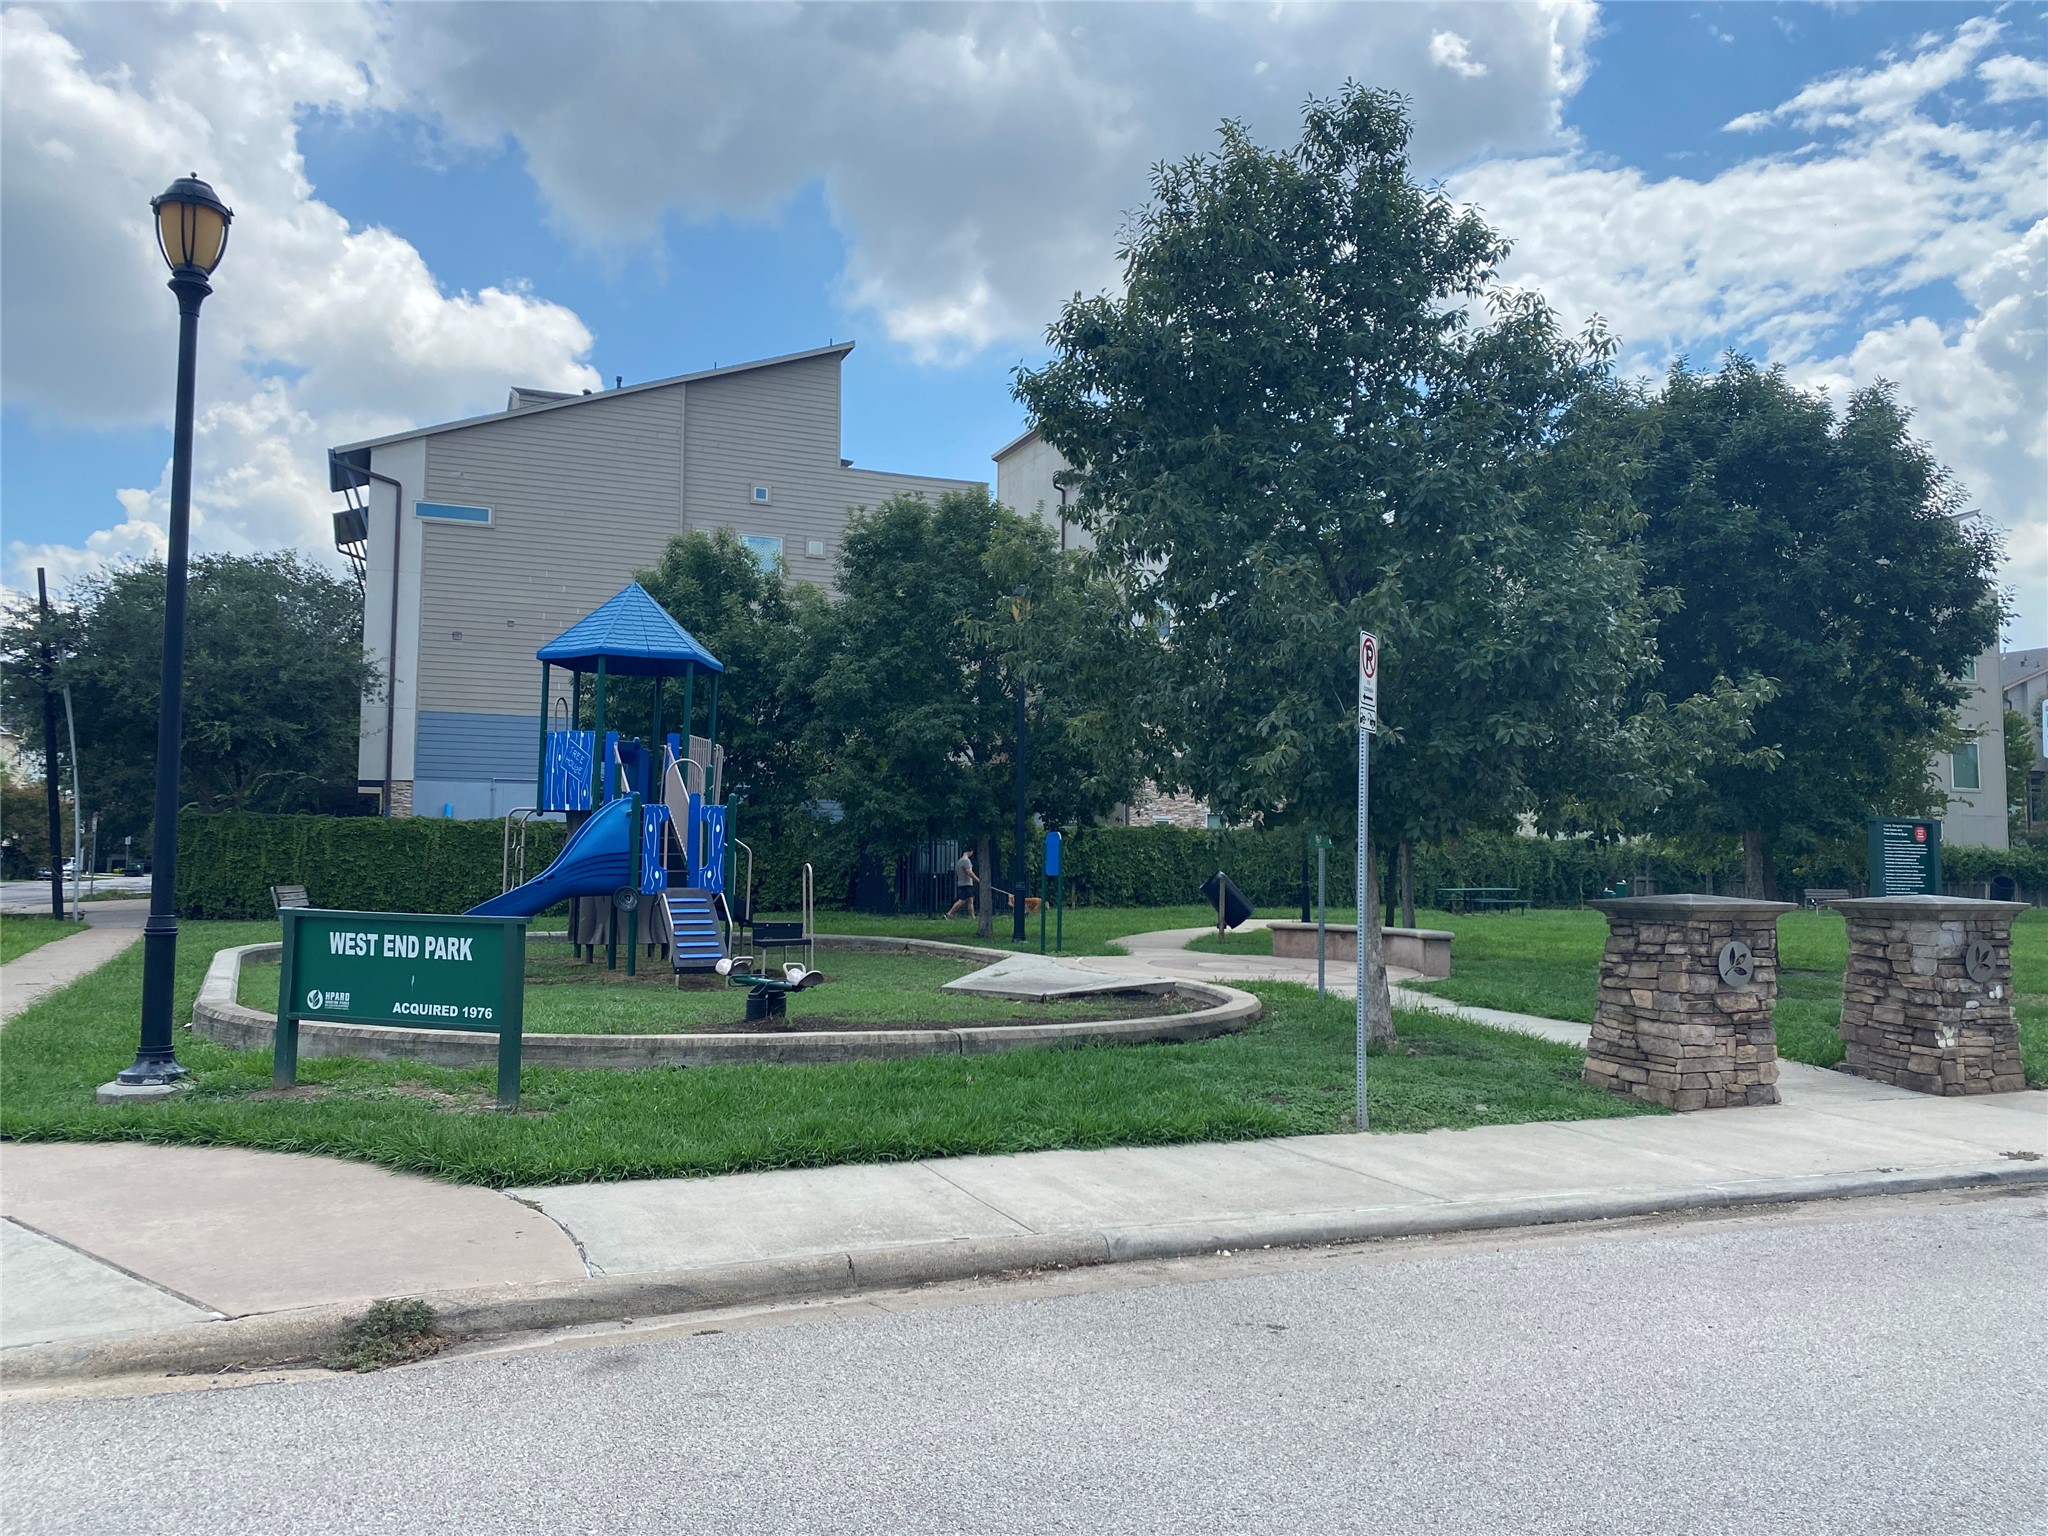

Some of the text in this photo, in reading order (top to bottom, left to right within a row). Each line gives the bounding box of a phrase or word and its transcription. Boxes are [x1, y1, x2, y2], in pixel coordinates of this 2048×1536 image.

[569, 746, 585, 764] TREE
[329, 932, 473, 961] WEST END PARK
[392, 1002, 493, 1019] ACQUIRED 1976
